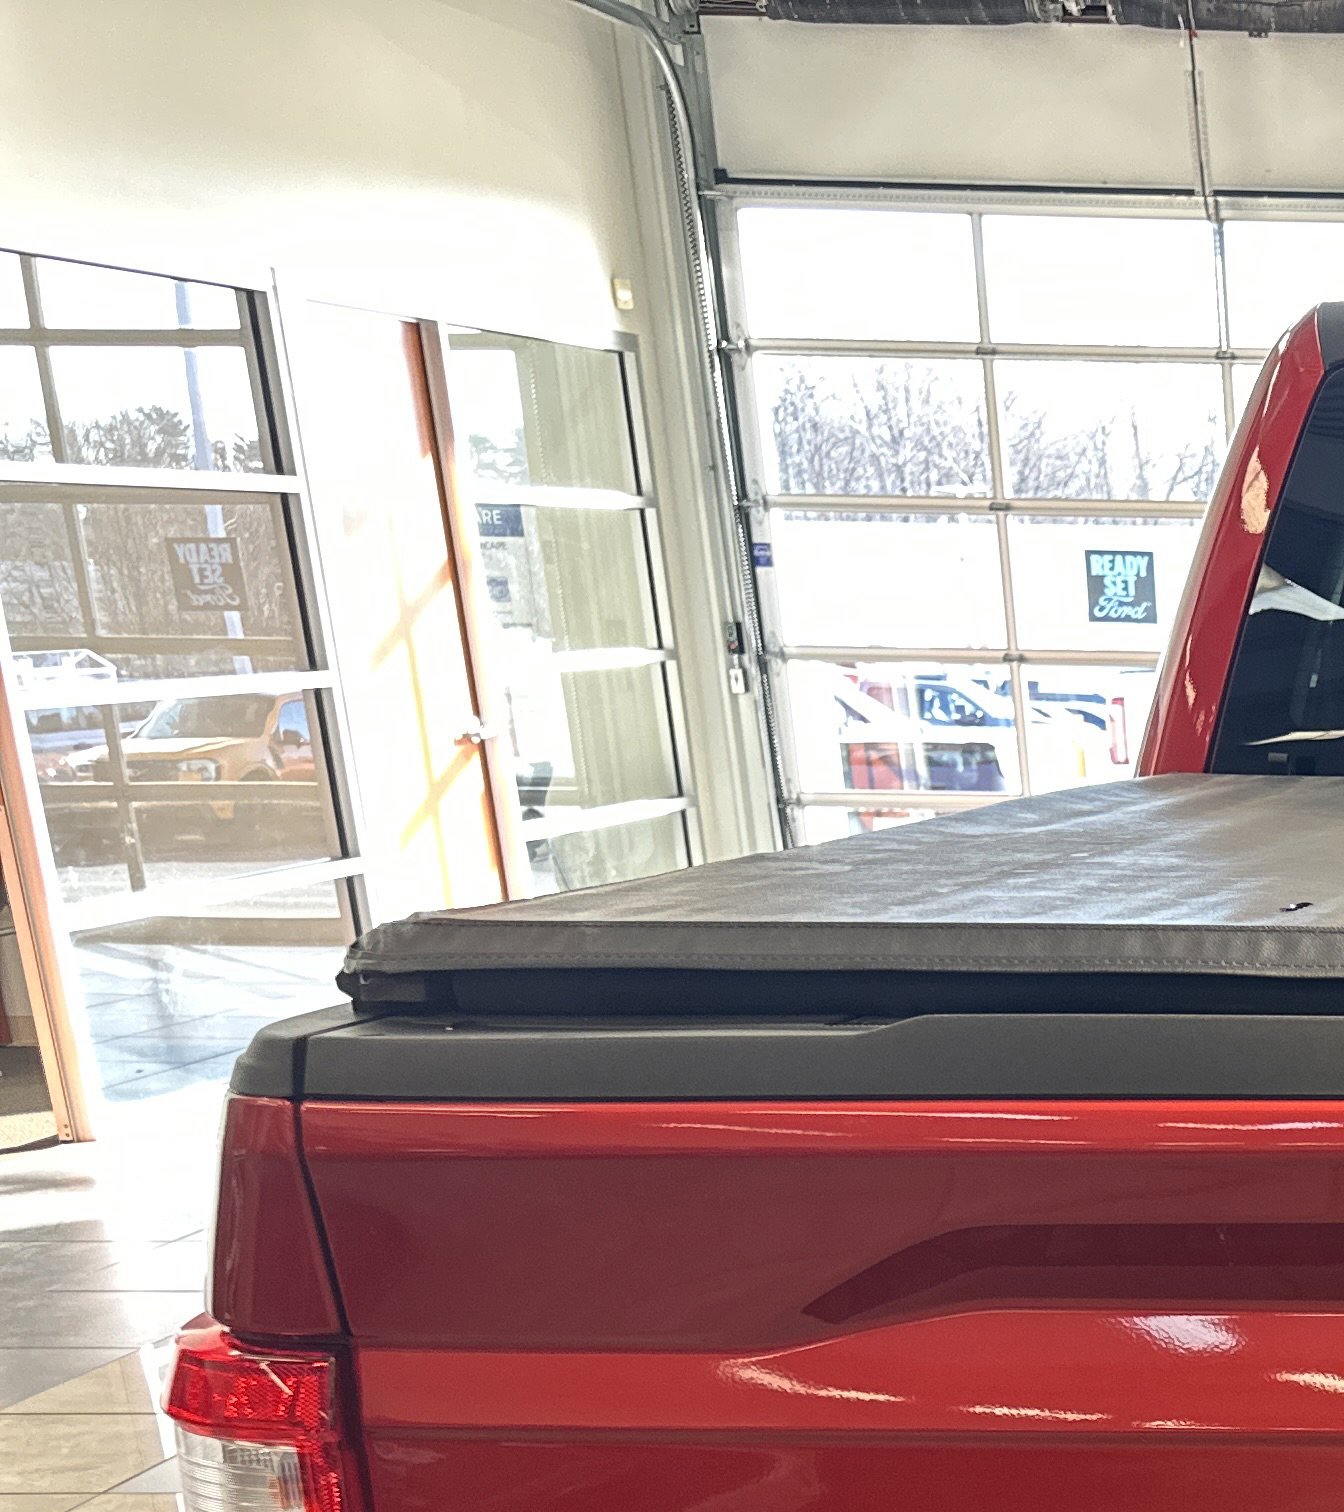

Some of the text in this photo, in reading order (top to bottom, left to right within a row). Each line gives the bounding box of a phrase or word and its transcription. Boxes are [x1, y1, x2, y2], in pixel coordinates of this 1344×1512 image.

[1089, 554, 1149, 577] READY
[1103, 575, 1137, 597] SET
[1093, 596, 1148, 619] Ford
